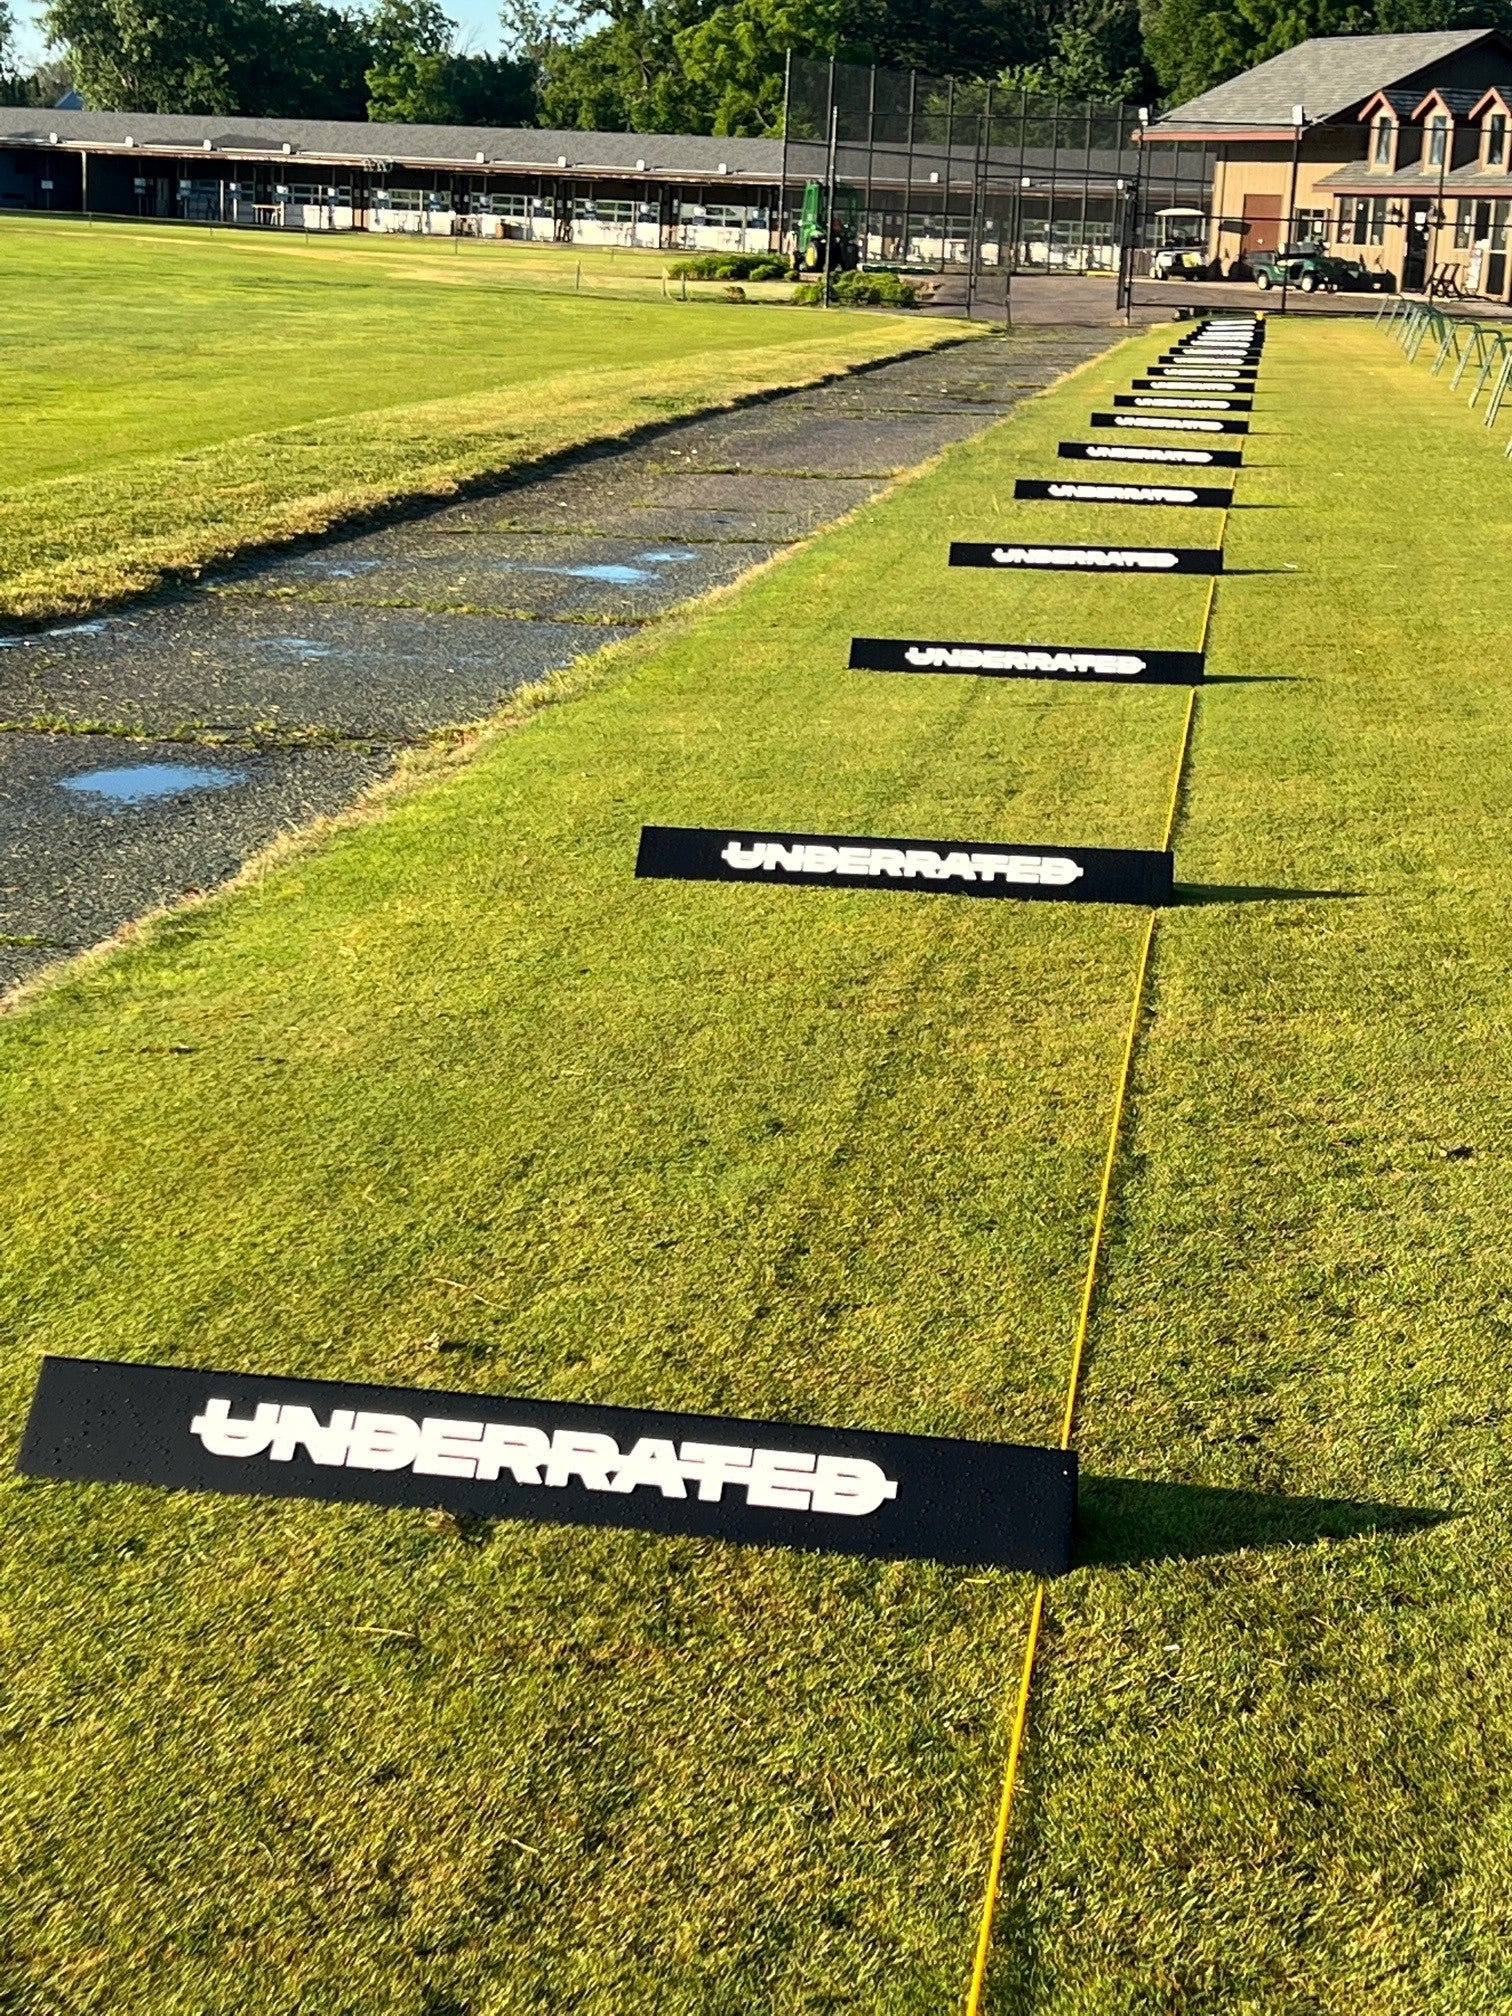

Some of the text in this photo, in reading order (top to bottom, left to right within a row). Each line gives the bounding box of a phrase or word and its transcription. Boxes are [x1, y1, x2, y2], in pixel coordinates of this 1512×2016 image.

[905, 646, 1146, 675] UNDERRATED
[722, 840, 1083, 886] UNDERRATED
[190, 1398, 897, 1516] UNDERRATED
